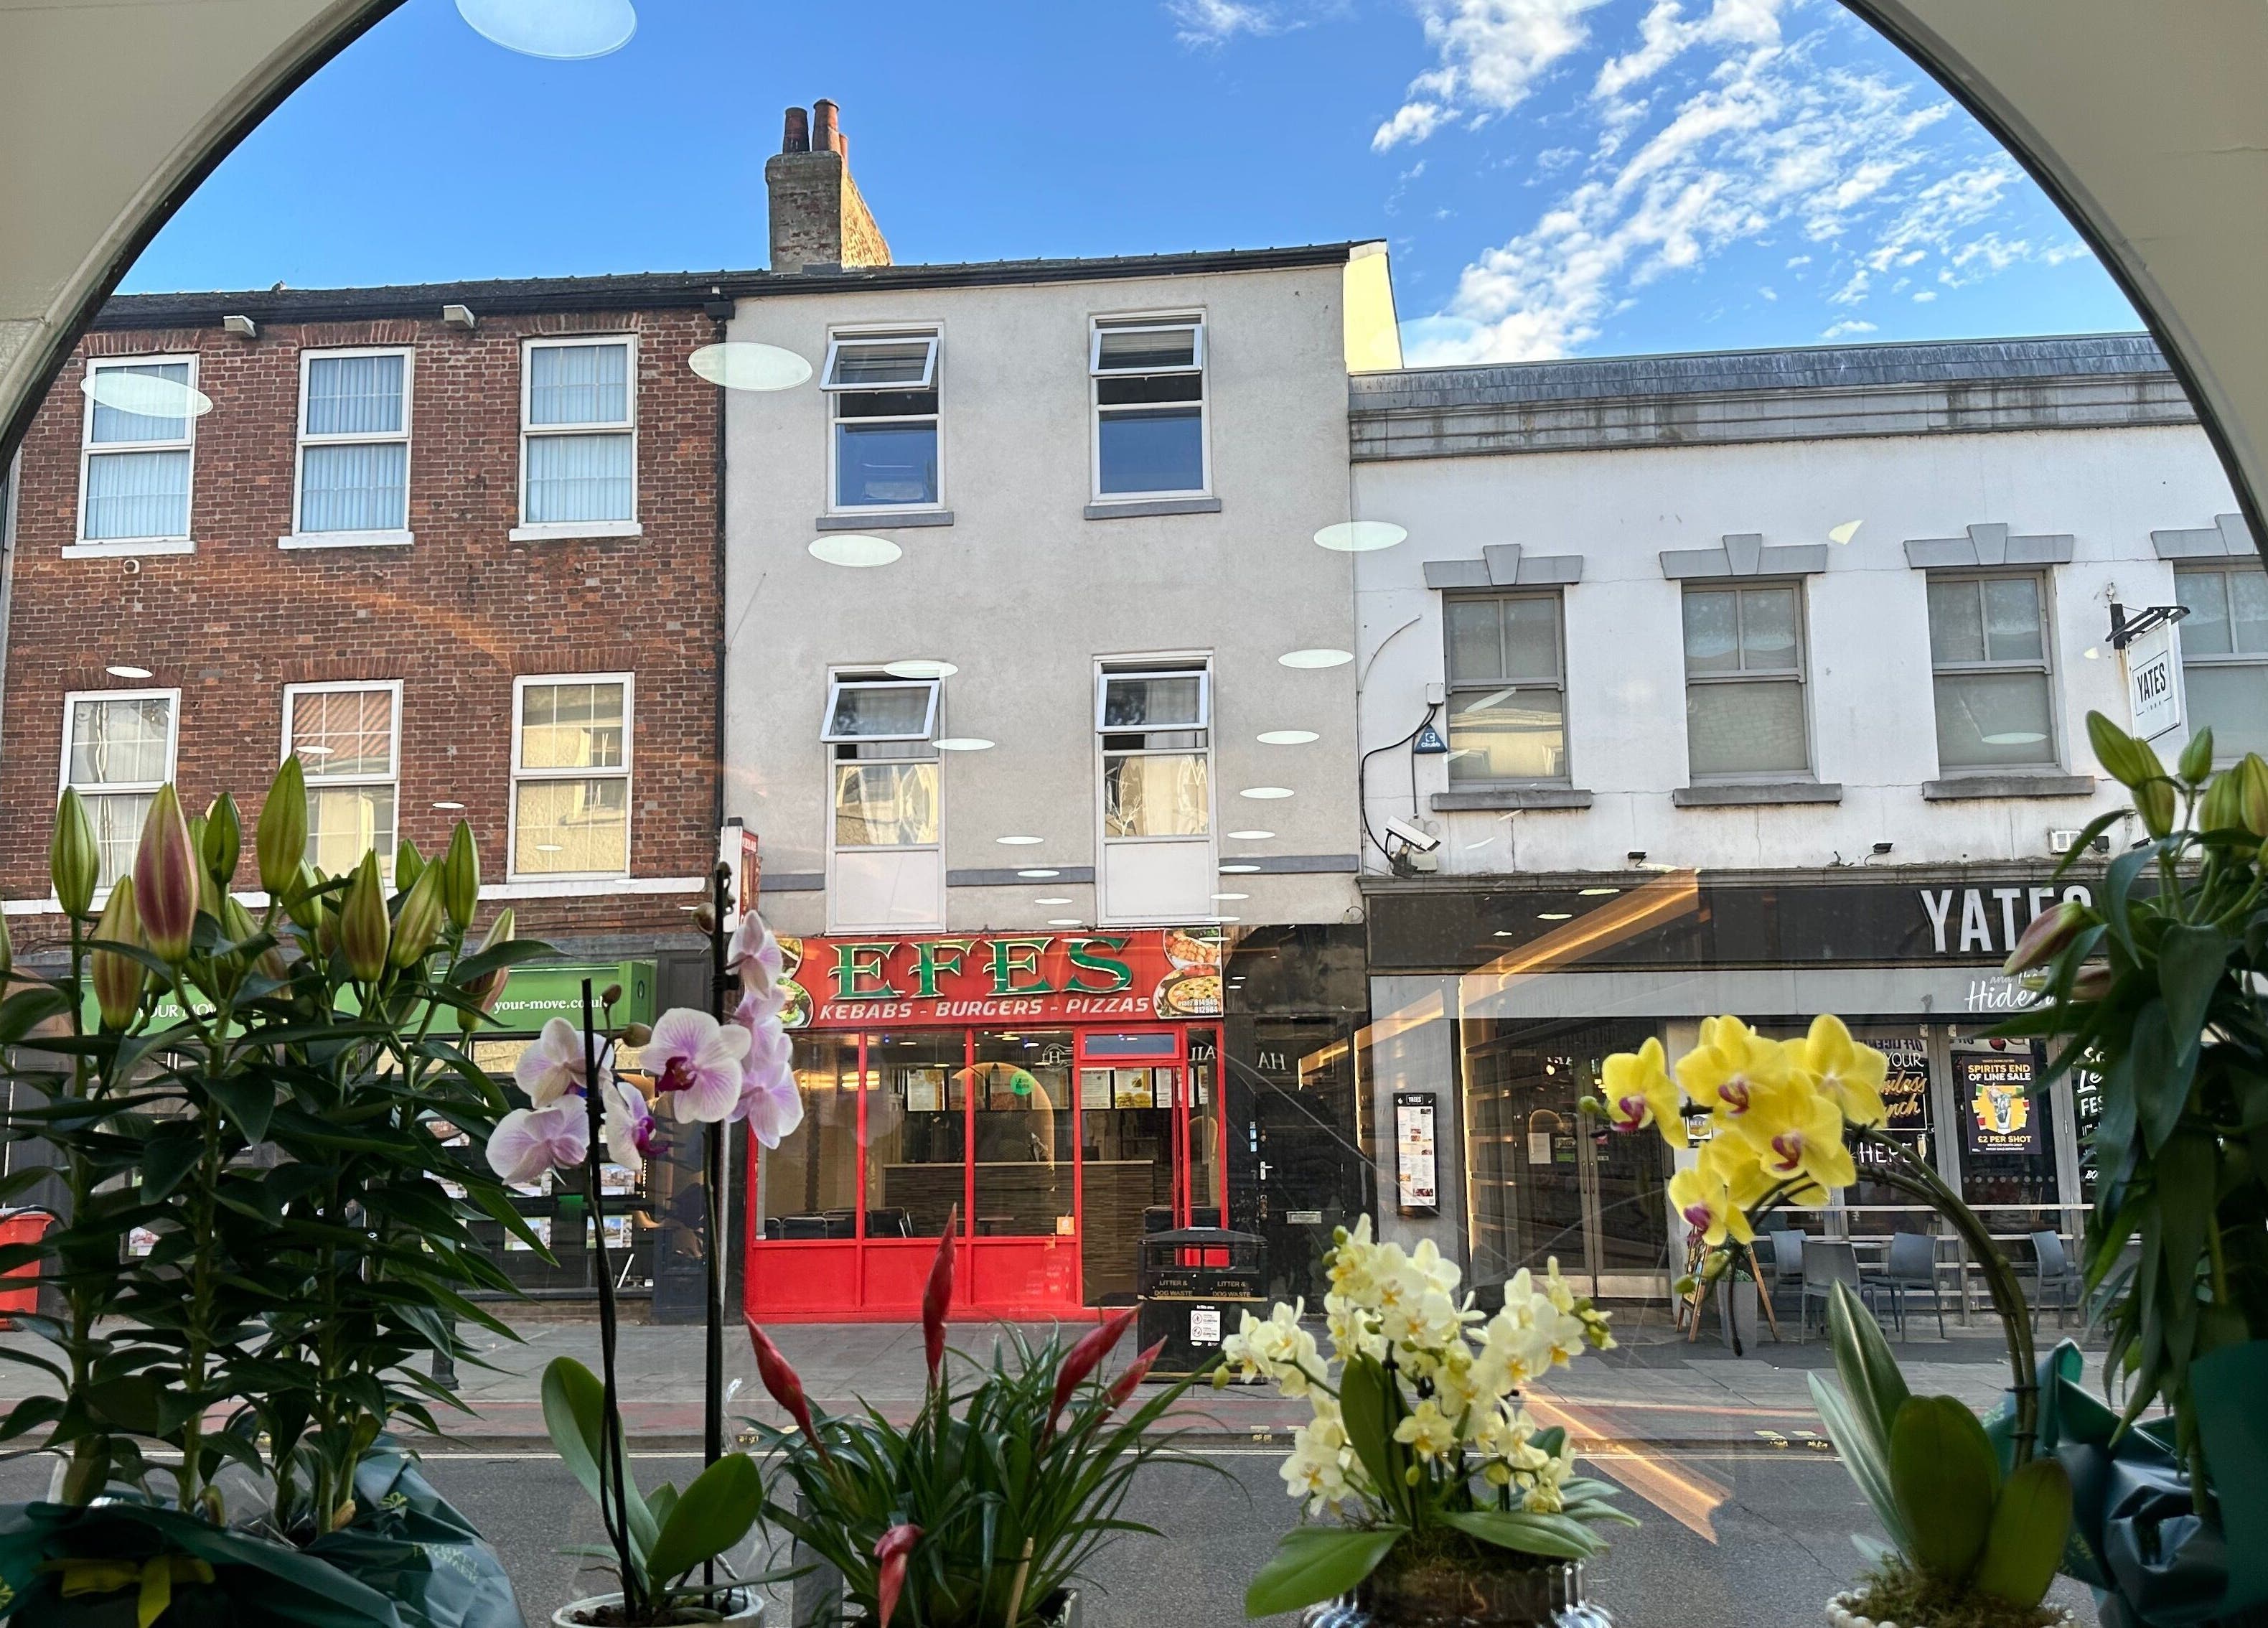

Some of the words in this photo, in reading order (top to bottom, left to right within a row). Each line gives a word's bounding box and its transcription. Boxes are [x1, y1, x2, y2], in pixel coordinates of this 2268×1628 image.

[2137, 662, 2166, 703] YATES
[828, 936, 1132, 1000] EFES
[820, 1002, 913, 1020] KEBABS
[935, 998, 1044, 1017] BURGERS
[1066, 997, 1150, 1014] PIZZAS
[1883, 1052, 1925, 1067] YOUR
[1968, 1065, 2007, 1073] SPIRITS
[2008, 1064, 2030, 1072] END
[1968, 1072, 1982, 1081] OF
[1984, 1072, 2006, 1081] LINE
[2007, 1072, 2032, 1081] SALE
